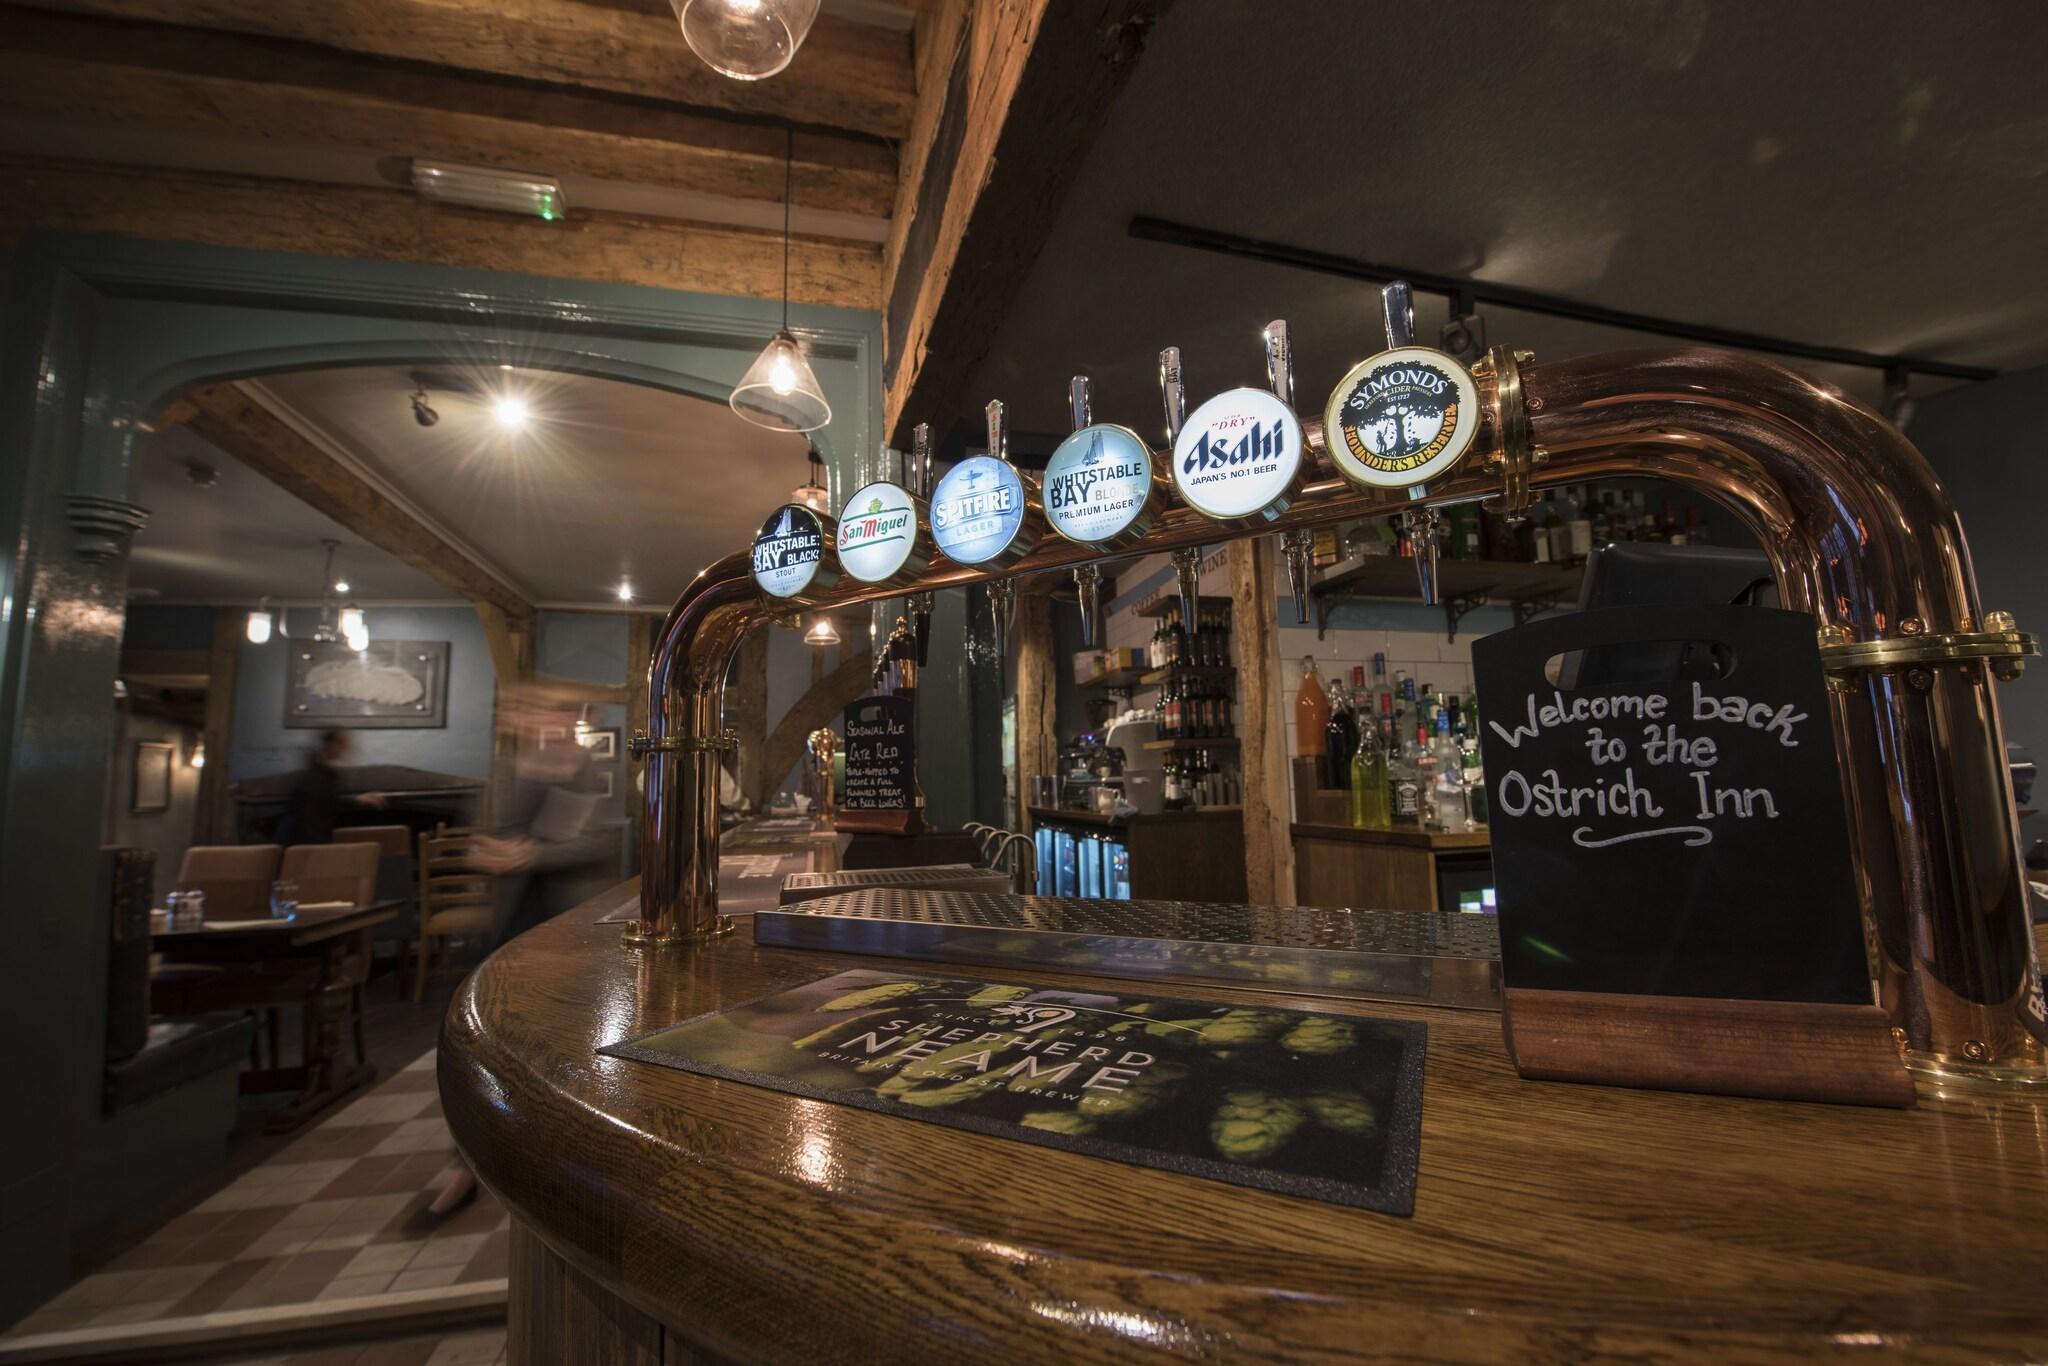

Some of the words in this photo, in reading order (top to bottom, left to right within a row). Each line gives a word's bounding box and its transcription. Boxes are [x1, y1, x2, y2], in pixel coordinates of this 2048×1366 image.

[1350, 369, 1449, 410] SYMONDS
[1386, 385, 1411, 395] CIDER
[1183, 418, 1283, 474] Asahi
[1413, 403, 1457, 467] RESERVE
[1052, 462, 1143, 490] WHITSTABLE
[1190, 472, 1227, 486] JAPAN'S
[1254, 464, 1278, 475] BEER
[935, 488, 1011, 526] SPITFIRE
[1050, 480, 1092, 510] BAY
[1058, 505, 1101, 520] PREMIUM
[1104, 499, 1134, 512] LAGER
[956, 520, 994, 536] LAGER
[754, 534, 817, 558] WHITSTABLE
[753, 550, 781, 573] BAY
[787, 550, 819, 566] BLACK
[775, 567, 797, 579] STOUT
[887, 719, 905, 735] ALE
[1489, 690, 1668, 748] Welcome
[1692, 681, 1808, 747] back
[876, 742, 898, 760] RED
[1585, 727, 1627, 766] to
[1641, 723, 1719, 768] the
[1499, 767, 1664, 818] Ostrich
[1689, 771, 1780, 820] Inn
[932, 1012, 997, 1026] SINCE
[878, 1018, 1156, 1067] SHEPHERD
[1057, 1028, 1127, 1042] 1698
[838, 1031, 1141, 1094] NEAME
[922, 1070, 1006, 1089] OLDEST
[1015, 1085, 1111, 1107] BREWER
